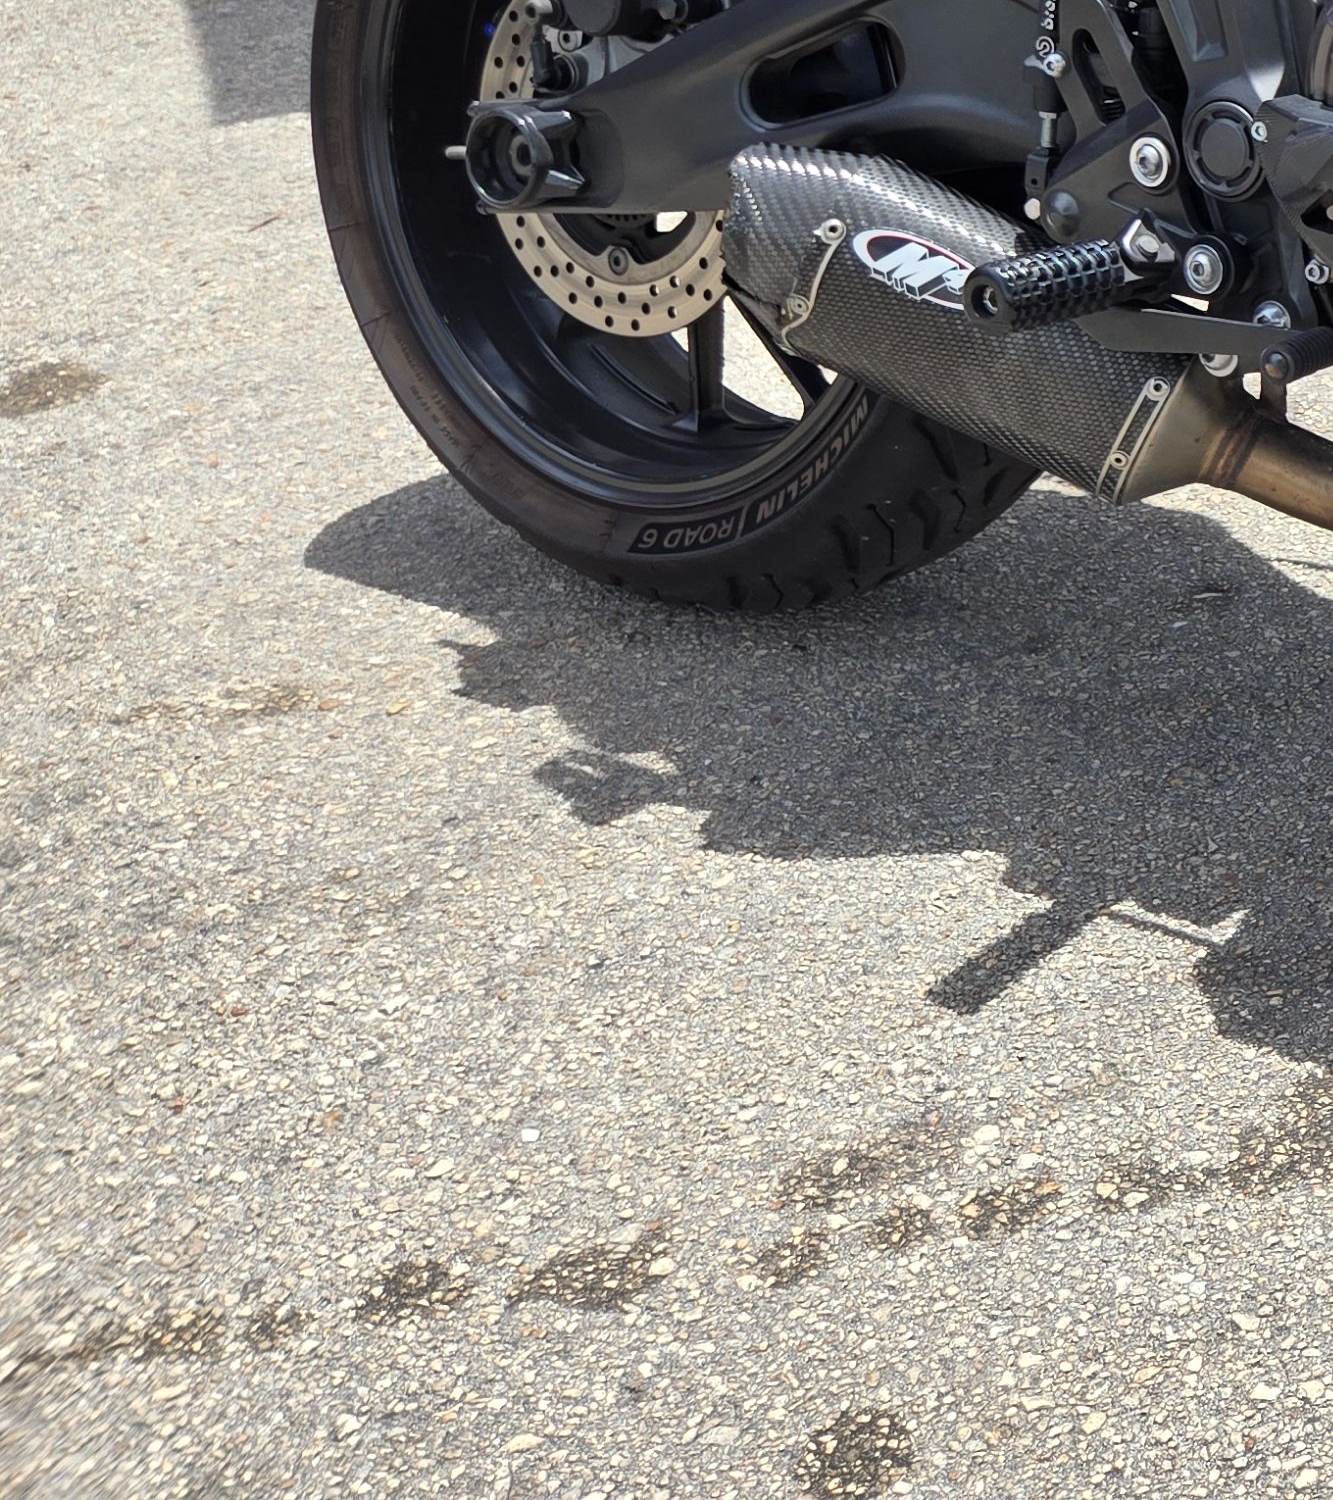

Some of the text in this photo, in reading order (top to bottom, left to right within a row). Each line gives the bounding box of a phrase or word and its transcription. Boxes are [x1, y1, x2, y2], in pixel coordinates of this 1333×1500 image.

[638, 394, 868, 550] MICHELIN ROAD 6
